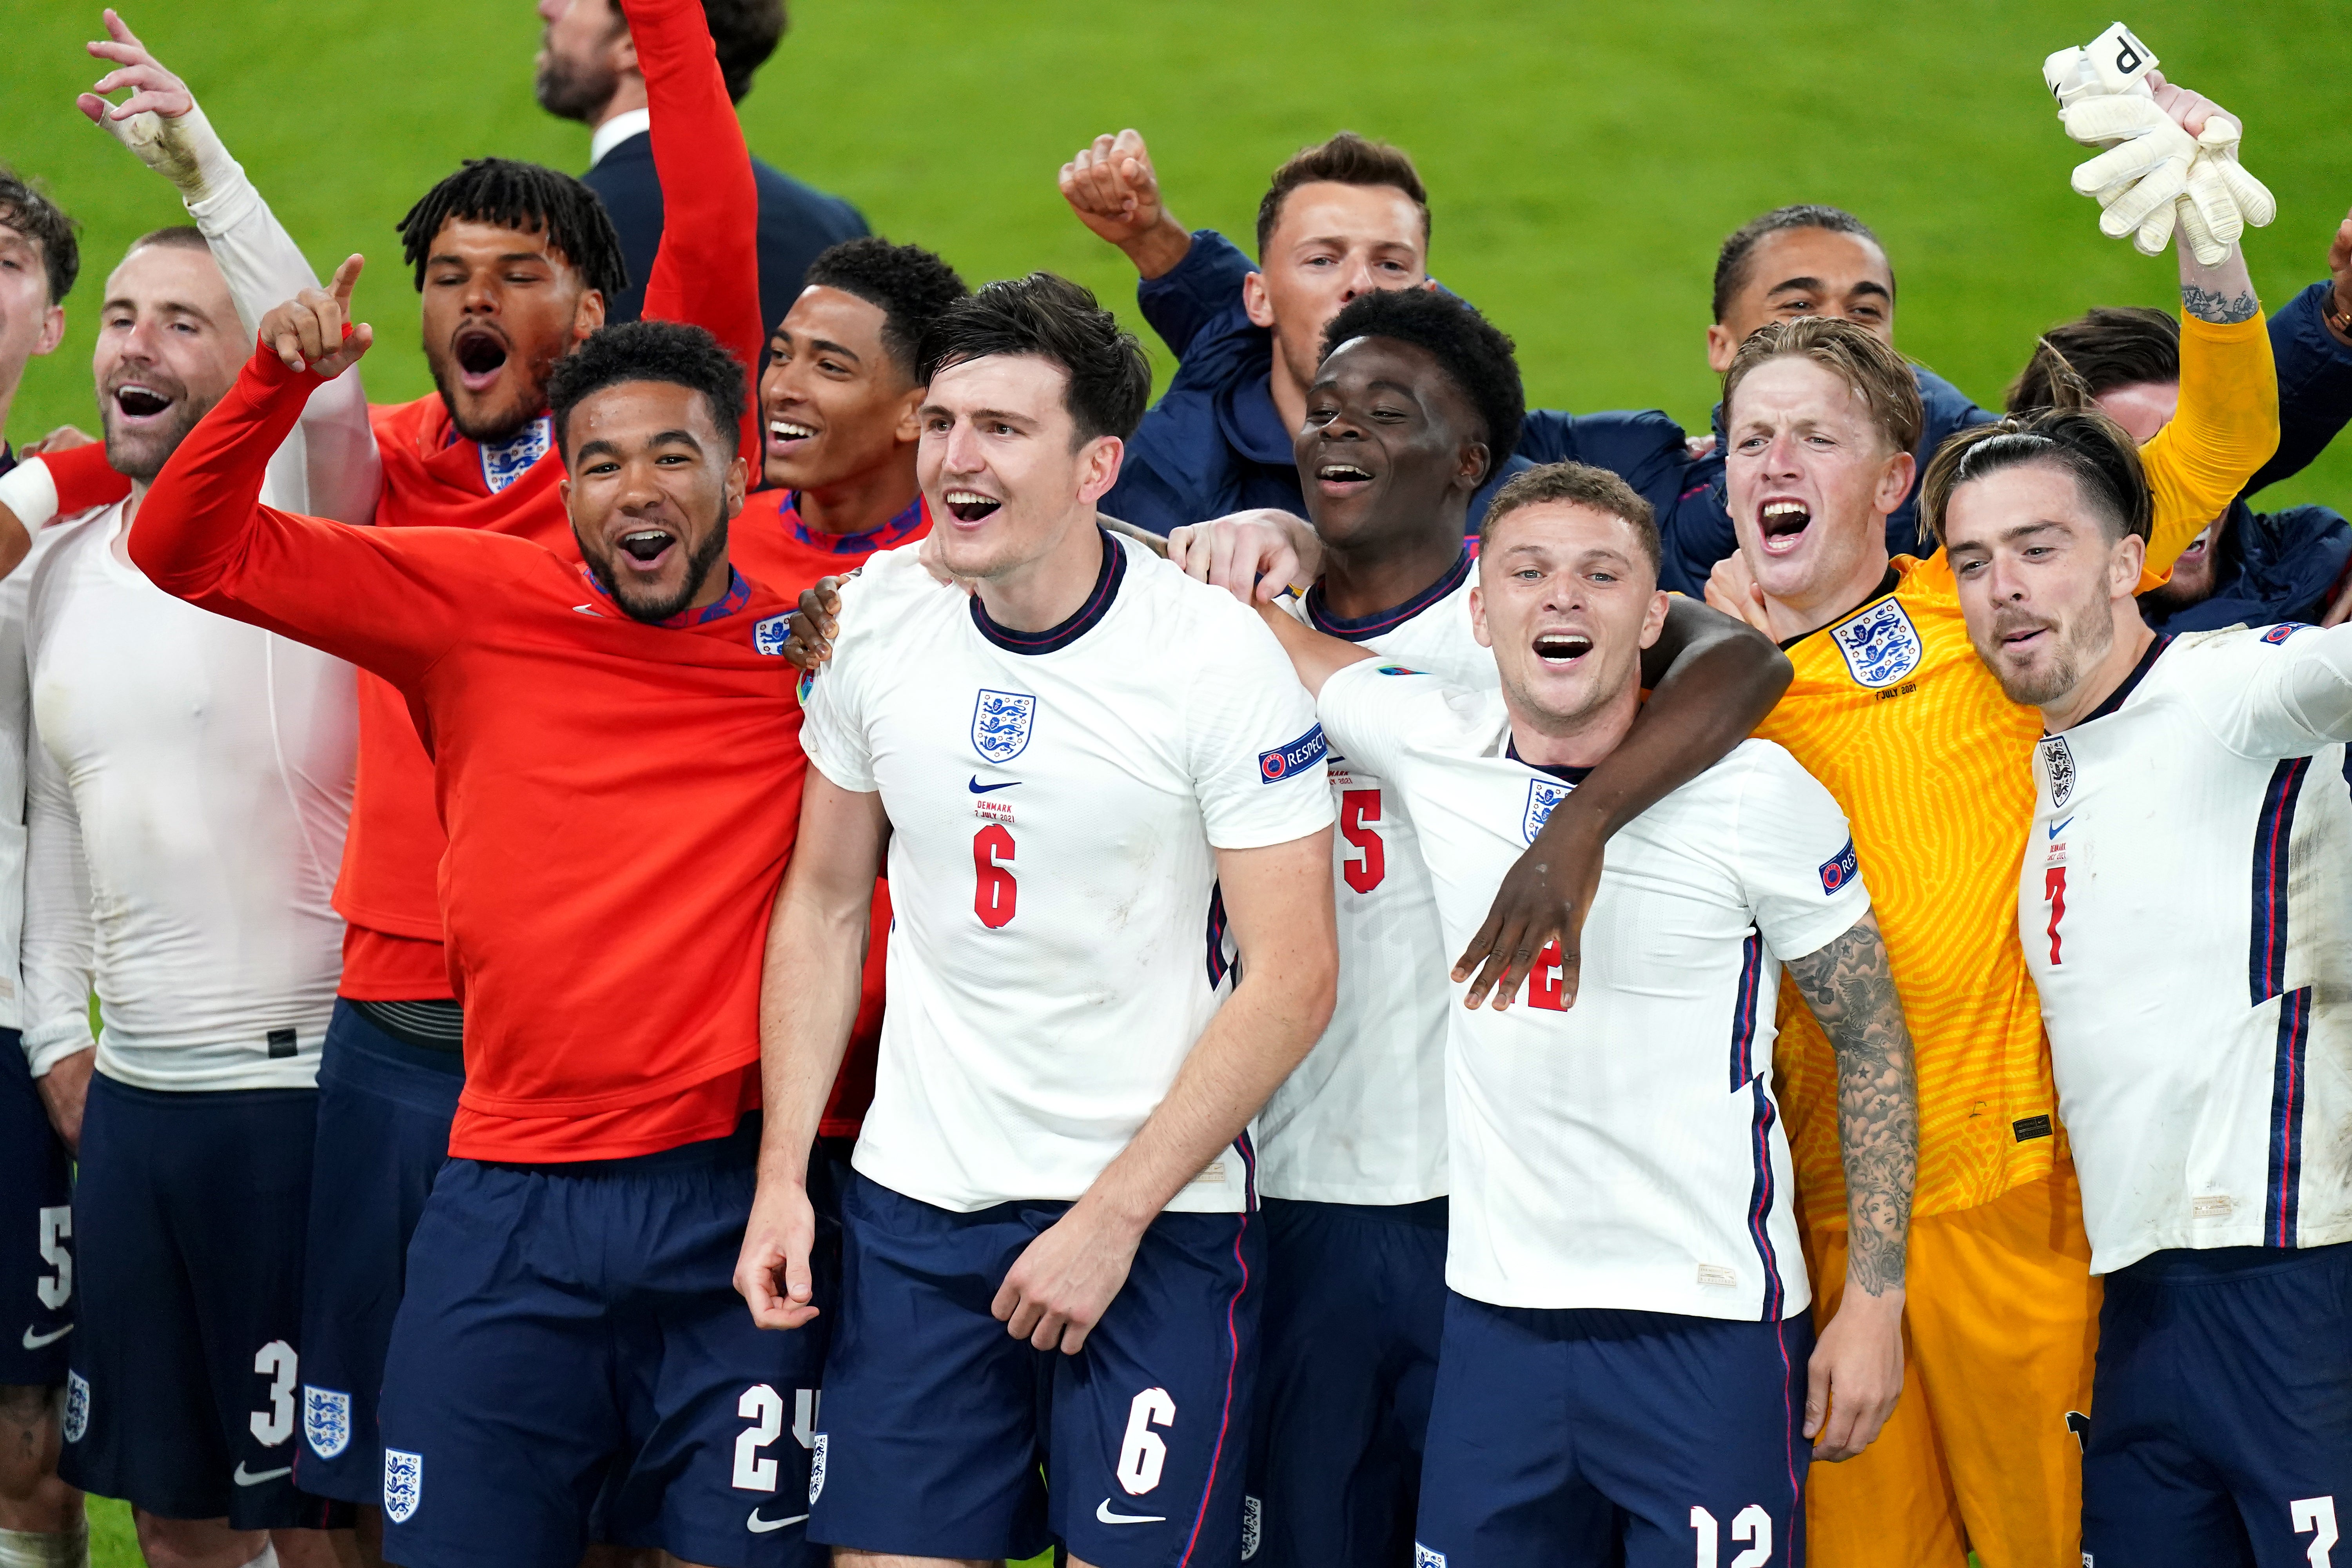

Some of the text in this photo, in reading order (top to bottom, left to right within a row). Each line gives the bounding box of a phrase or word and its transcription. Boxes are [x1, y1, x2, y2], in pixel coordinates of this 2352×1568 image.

[1882, 688, 1898, 699] JULY
[1901, 684, 1916, 694] 2021
[1287, 731, 1325, 767] RESPECT
[977, 800, 1012, 813] DENMARK
[1000, 814, 1014, 823] 2021
[1341, 789, 1385, 894] 5
[973, 823, 1017, 929] 6
[1842, 845, 1856, 874] RES
[2045, 866, 2067, 965] 7
[37, 1205, 72, 1310] 5
[250, 1339, 298, 1447] 3
[732, 1383, 821, 1492] 24
[1116, 1387, 1176, 1495] 6
[1690, 1504, 1772, 1568] 12
[2290, 1495, 2339, 1568] 7
